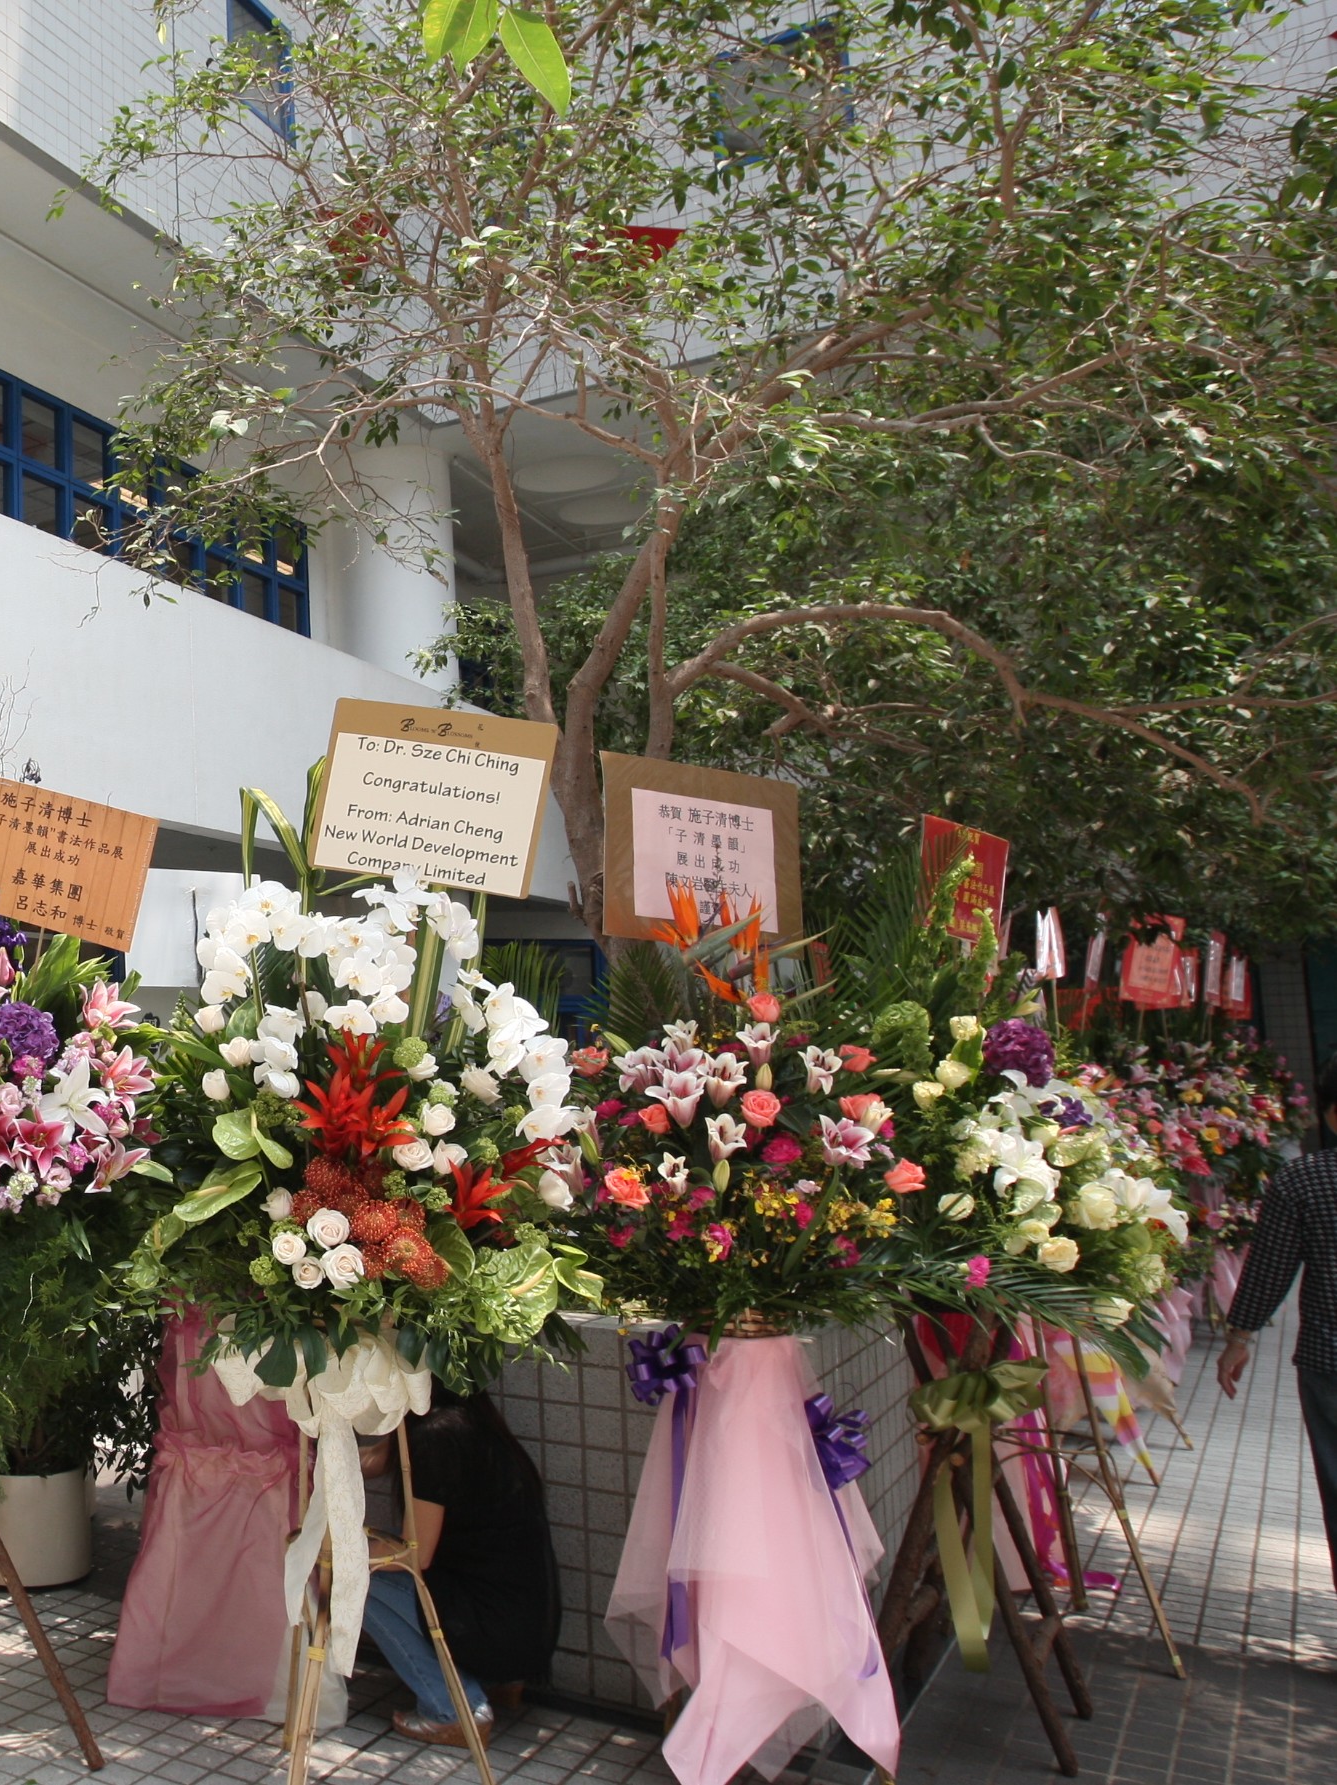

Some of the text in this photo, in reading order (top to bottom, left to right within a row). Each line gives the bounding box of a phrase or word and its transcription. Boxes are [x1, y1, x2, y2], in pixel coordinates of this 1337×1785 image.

[357, 737, 519, 776] To: Dr. Sze Chi Ching
[362, 771, 501, 805] Congratulations!
[0, 791, 93, 828] 施子清博士
[346, 804, 504, 844] From: Adrian Cheng
[688, 808, 754, 832] 施子清博士
[25, 841, 80, 867] 展出成功
[324, 824, 519, 868] New World Development
[11, 867, 83, 902] 嘉華集團
[424, 863, 486, 886] Limited
[15, 894, 67, 920] 呂志和
[72, 914, 98, 932] 博士
